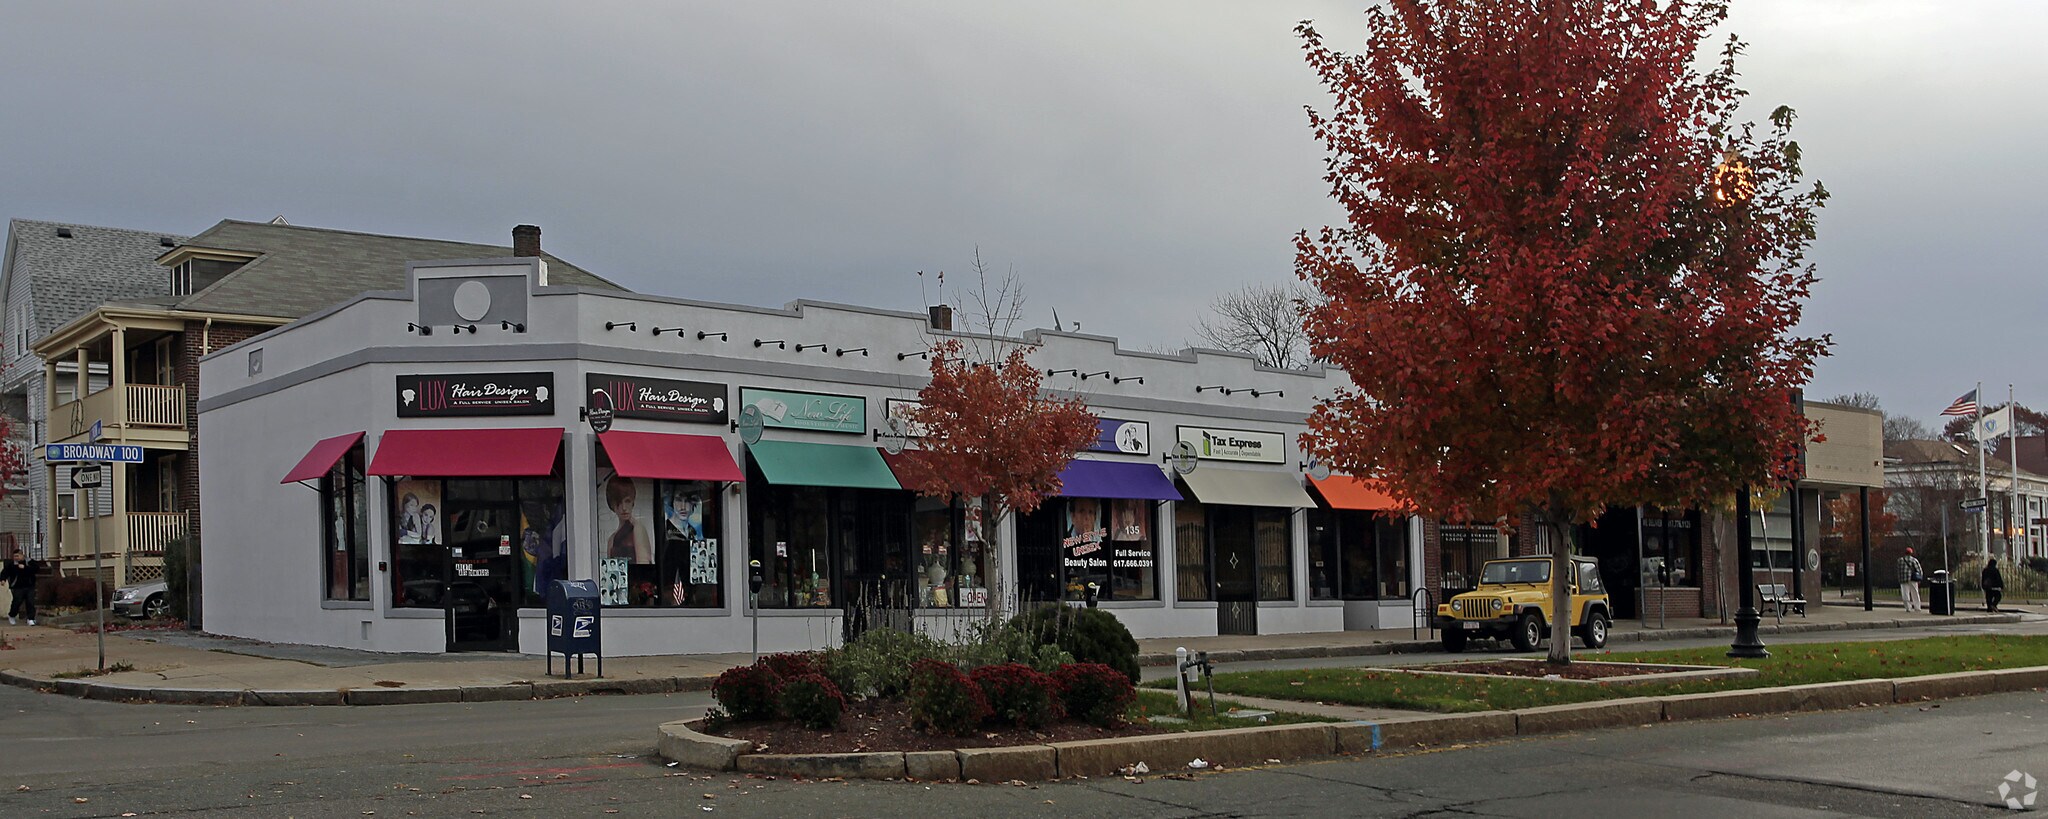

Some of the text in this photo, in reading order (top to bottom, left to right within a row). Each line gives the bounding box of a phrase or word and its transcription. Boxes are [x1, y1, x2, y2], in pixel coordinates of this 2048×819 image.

[419, 381, 529, 411] LUX Hair Design
[609, 380, 708, 412] LUX Hair Design
[791, 399, 855, 429] New Life
[1212, 436, 1262, 449] Tax Express
[63, 445, 139, 460] BROADWAY 100
[81, 473, 93, 483] ONE
[1125, 525, 1140, 535] 135
[1063, 527, 1107, 548] NEW STYLE
[1115, 549, 1151, 557] Full Service
[1064, 557, 1107, 569] Beauty Salon
